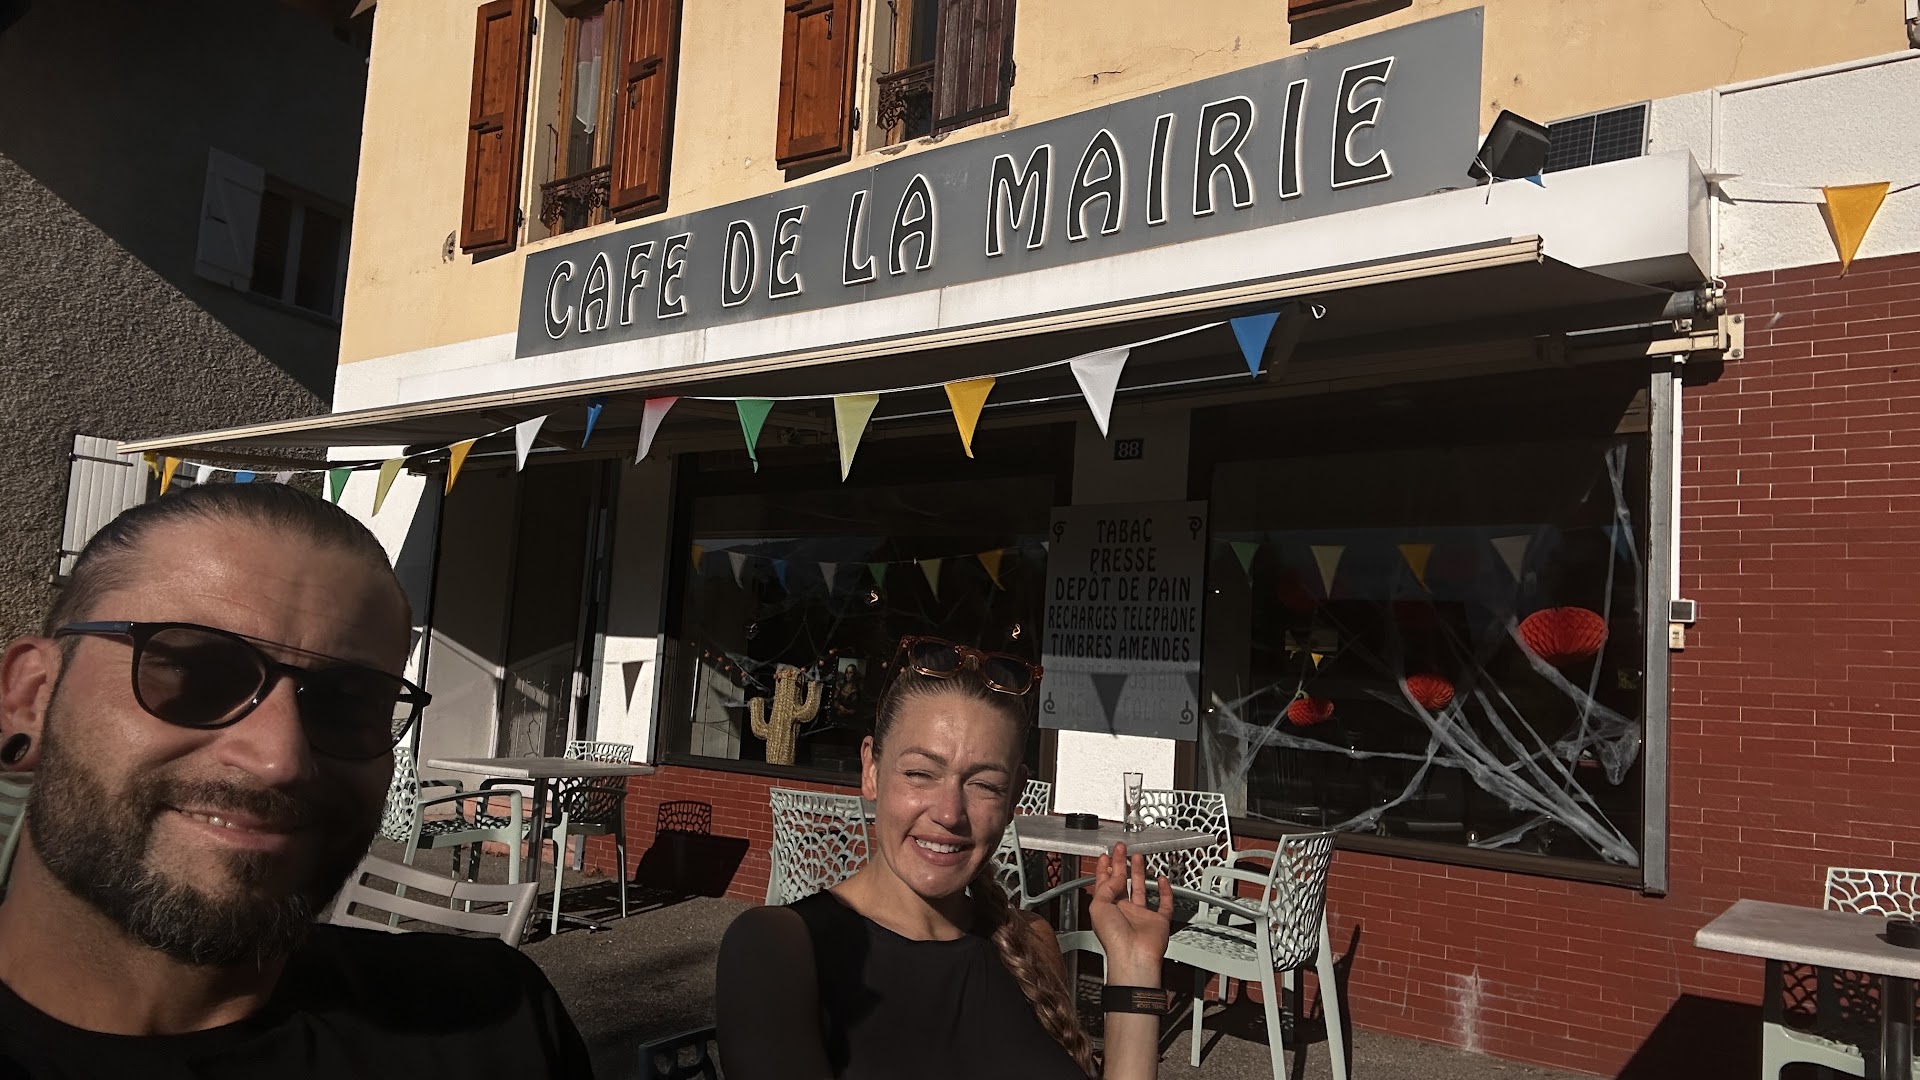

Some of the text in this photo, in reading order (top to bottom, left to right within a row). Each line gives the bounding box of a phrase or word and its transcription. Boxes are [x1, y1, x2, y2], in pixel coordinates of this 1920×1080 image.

[544, 56, 1395, 341] CAFE DE LA MAIRIE
[1118, 441, 1139, 458] 88
[1097, 518, 1152, 543] TABAC
[1090, 547, 1157, 572] PRESSE
[1118, 578, 1139, 601] DE
[1148, 577, 1191, 602] PAIN
[1048, 606, 1195, 633] RECHARGES TELEPHONE
[1051, 634, 1190, 662] TIMBRES AMENDES
